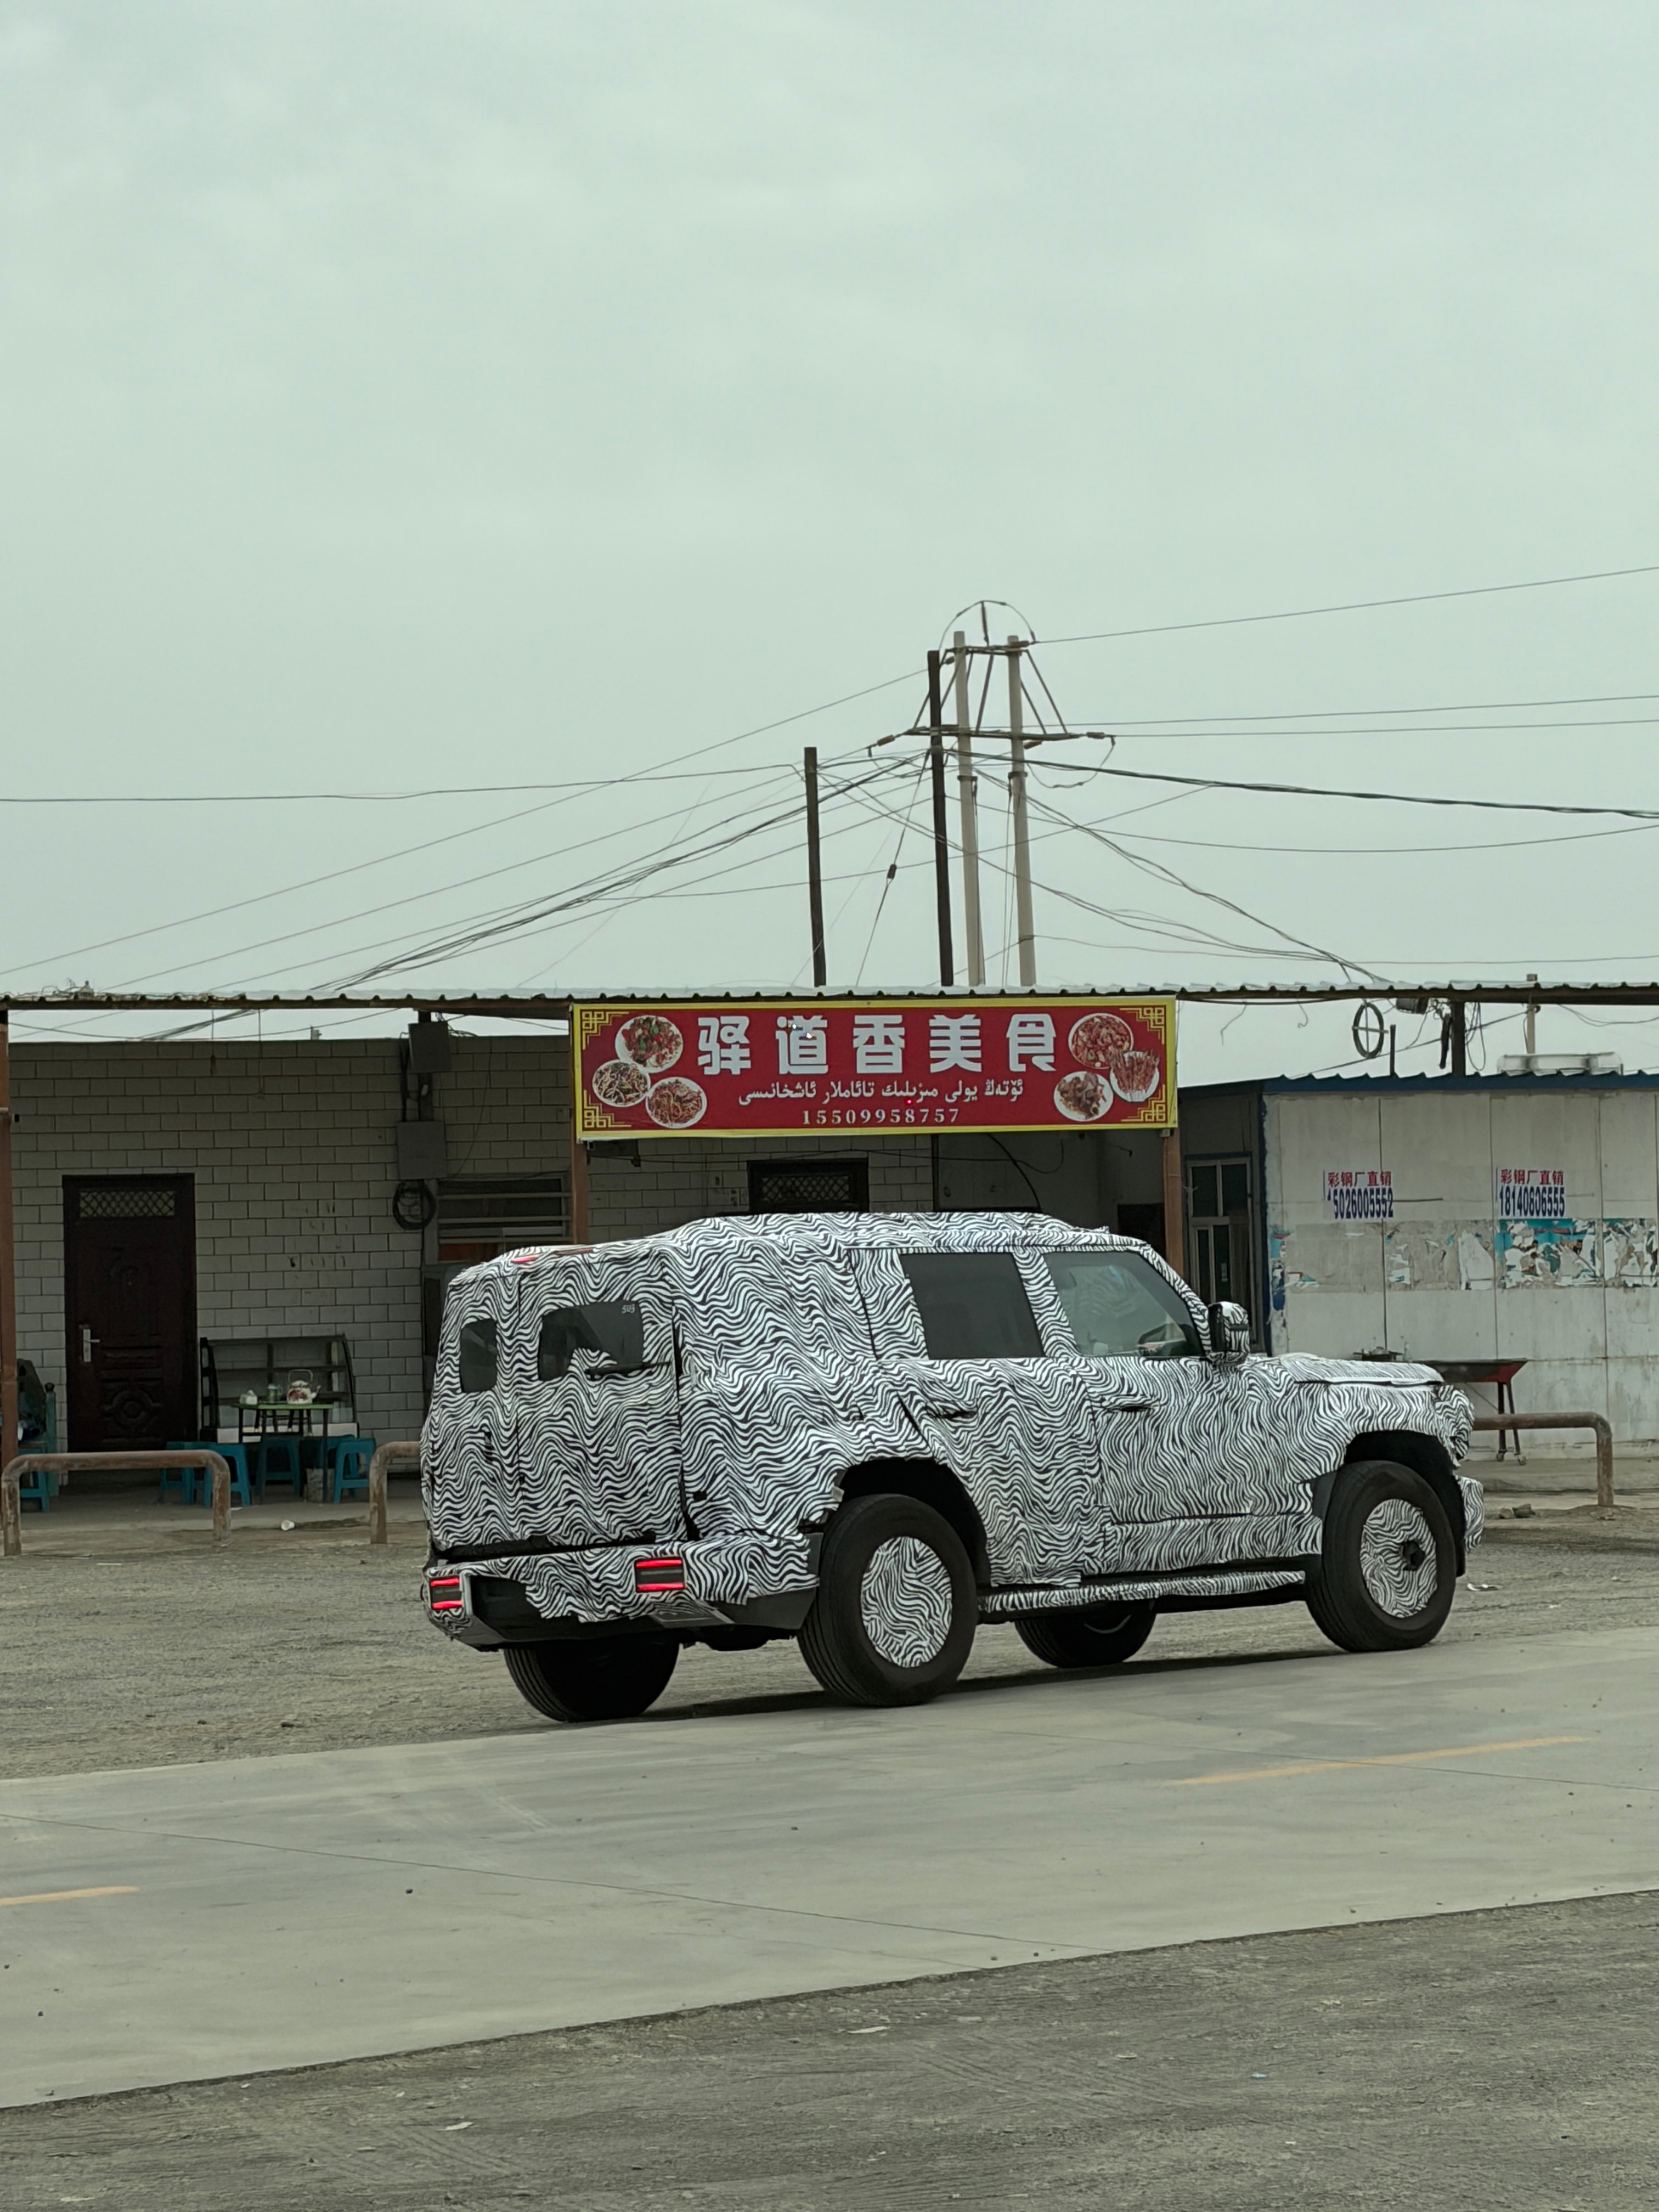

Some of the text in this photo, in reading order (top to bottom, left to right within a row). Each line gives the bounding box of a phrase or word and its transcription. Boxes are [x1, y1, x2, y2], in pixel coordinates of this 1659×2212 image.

[697, 1013, 1057, 1075] 驿道香美食
[803, 1109, 959, 1125] 15509958757
[1328, 1171, 1391, 1188] 彩钢厂直销
[1500, 1169, 1564, 1186] 彩钢厂直销
